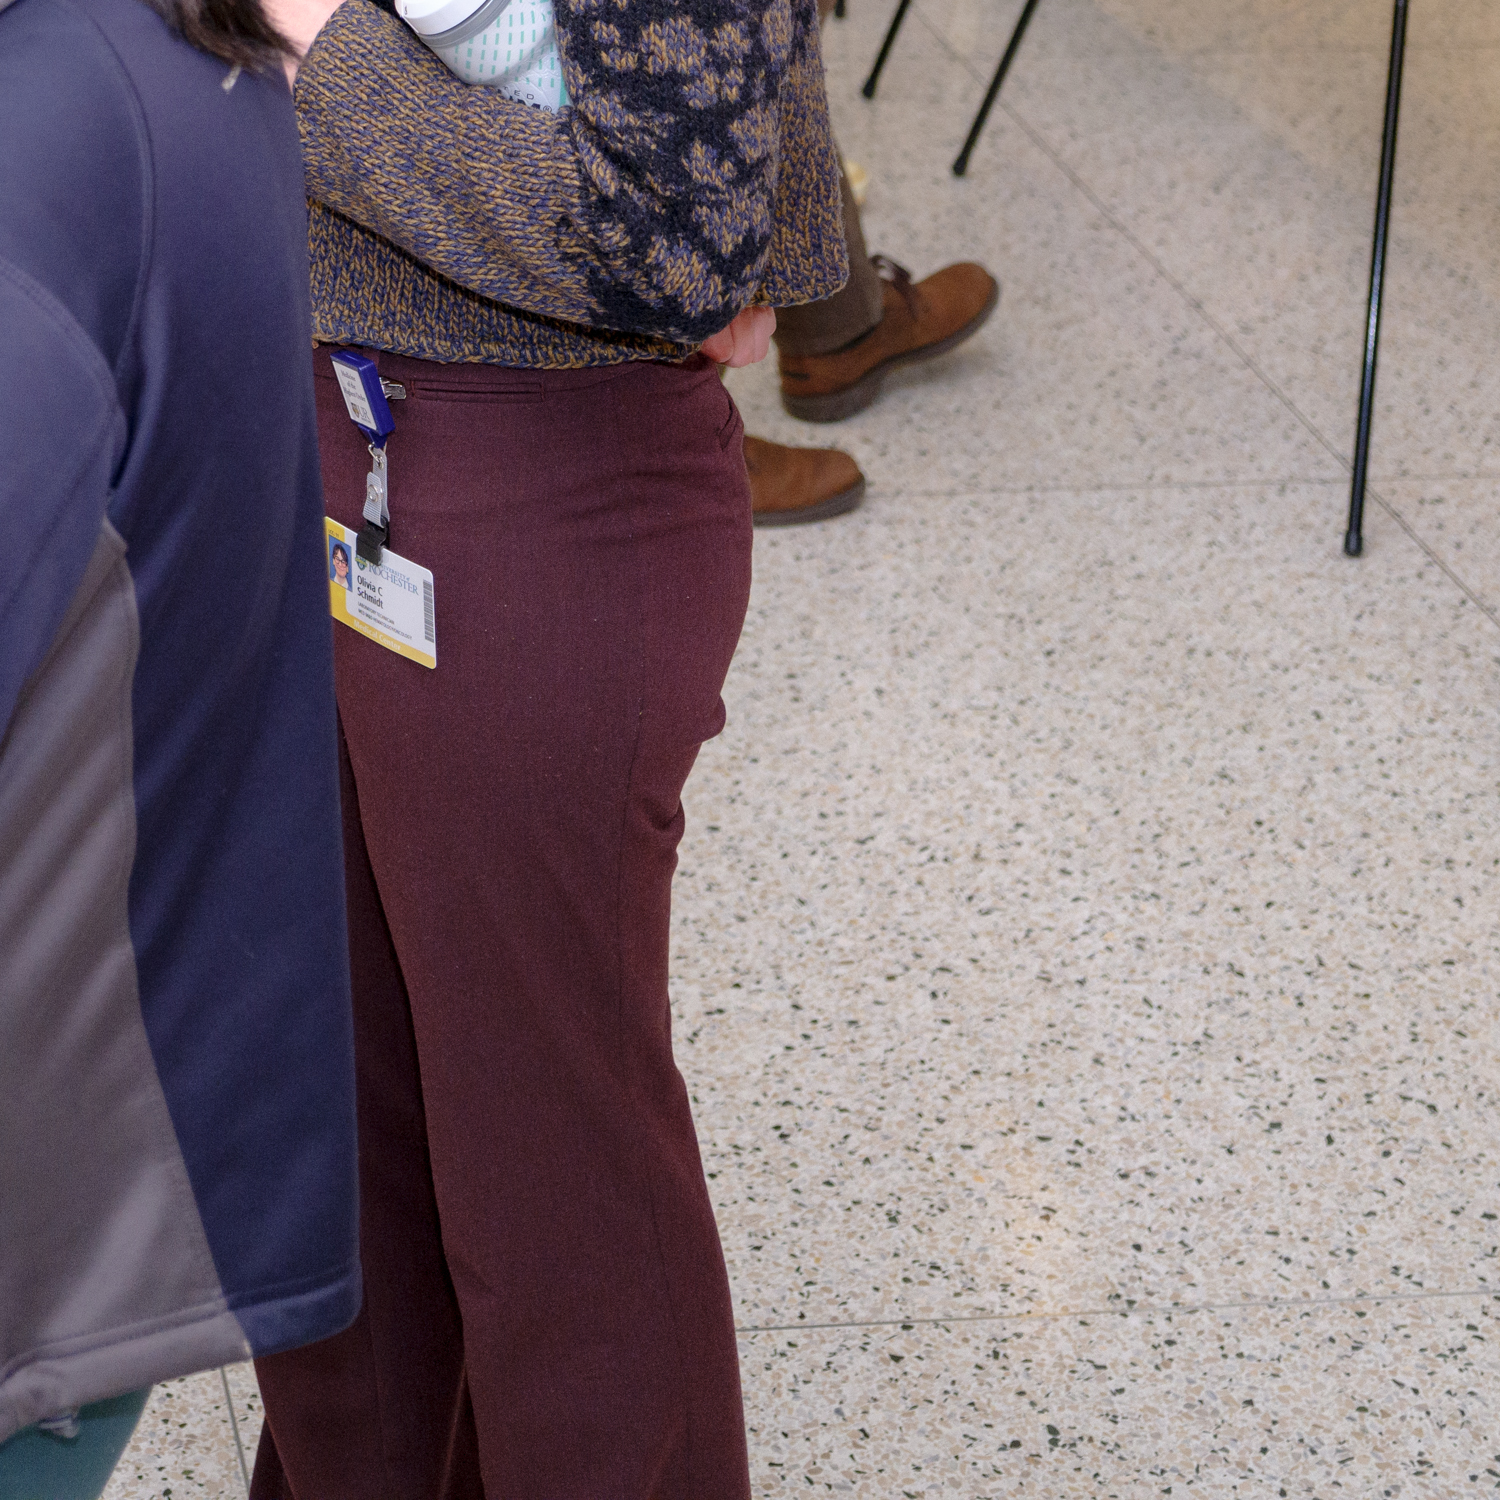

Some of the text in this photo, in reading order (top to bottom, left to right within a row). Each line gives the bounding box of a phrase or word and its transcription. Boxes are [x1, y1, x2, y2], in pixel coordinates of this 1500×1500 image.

[357, 575, 383, 597] Olivia C
[368, 561, 419, 595] ROCHESTER
[357, 587, 384, 609] Schmidt
[353, 620, 378, 638] Medical
[379, 634, 401, 652] Center
